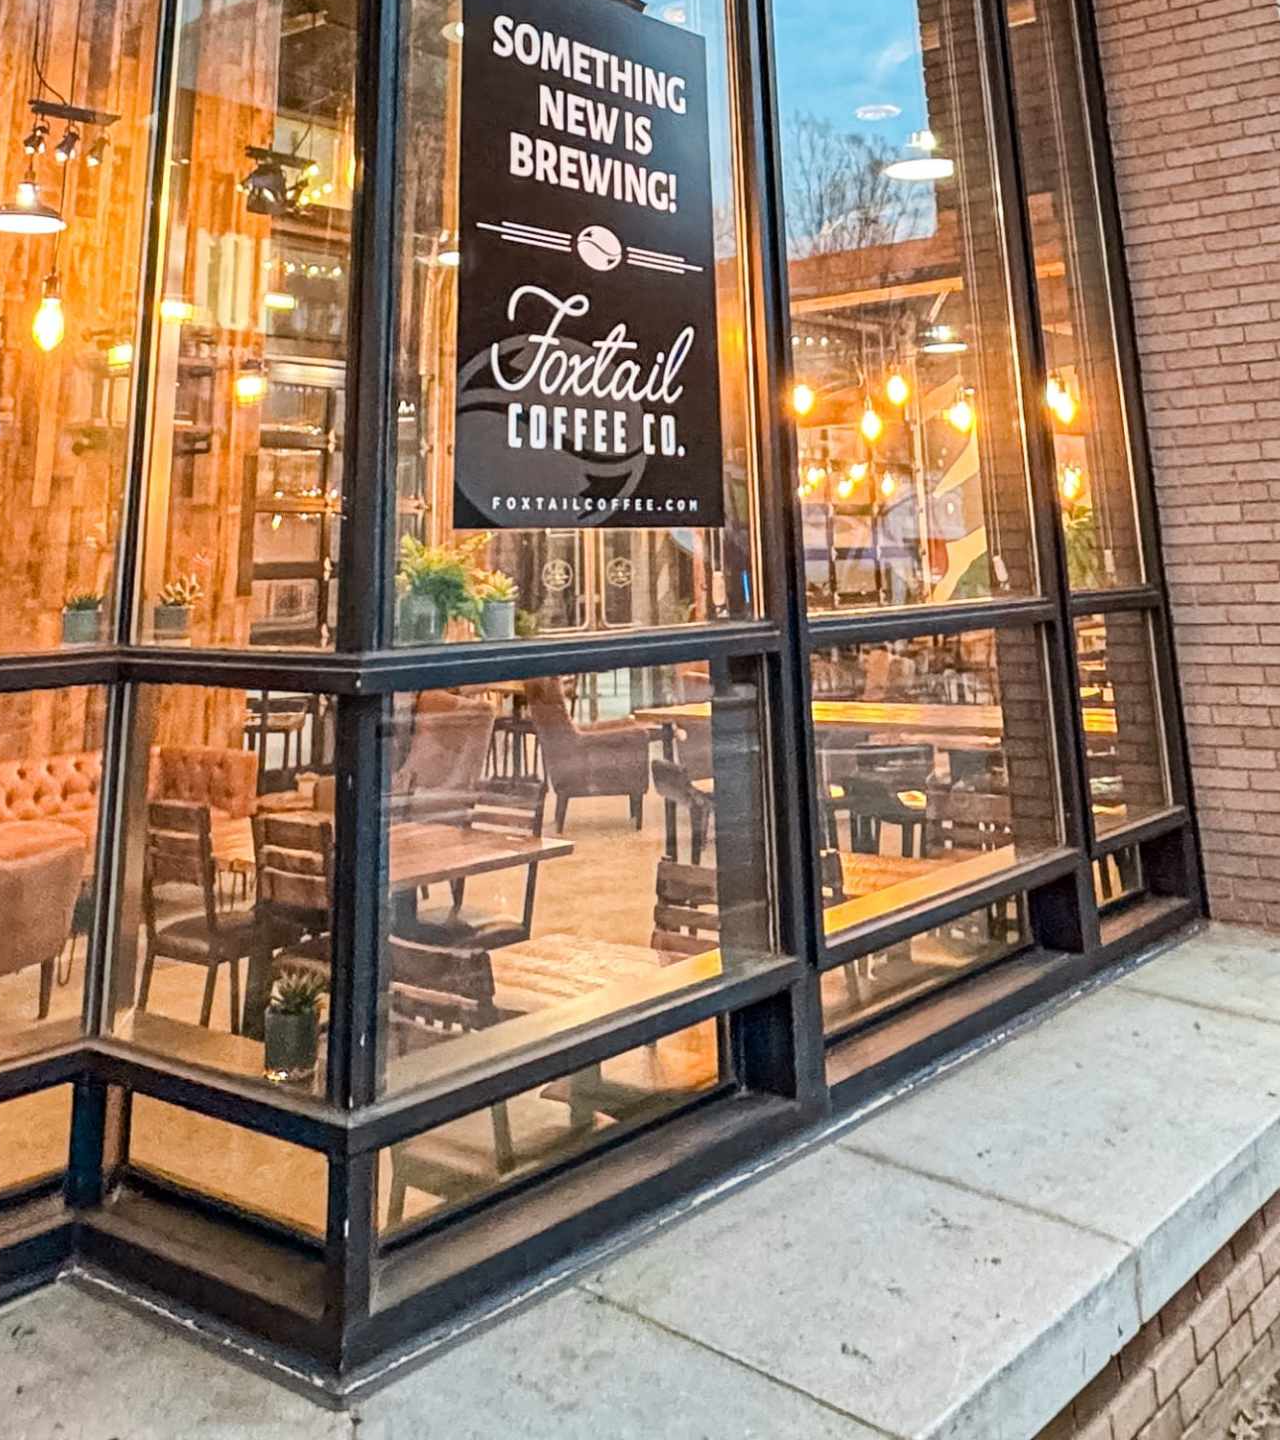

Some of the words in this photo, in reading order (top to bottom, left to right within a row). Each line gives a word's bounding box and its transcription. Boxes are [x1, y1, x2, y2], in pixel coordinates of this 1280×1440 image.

[492, 14, 687, 115] SOMETHING
[538, 84, 619, 144] NEW
[624, 111, 653, 156] IS
[509, 131, 678, 214] BREWING!
[490, 284, 695, 405] Foxtail
[507, 403, 628, 454] COFFEE
[642, 413, 686, 457] CO.
[492, 496, 699, 512] FOXTAILCOFFEE.COM
